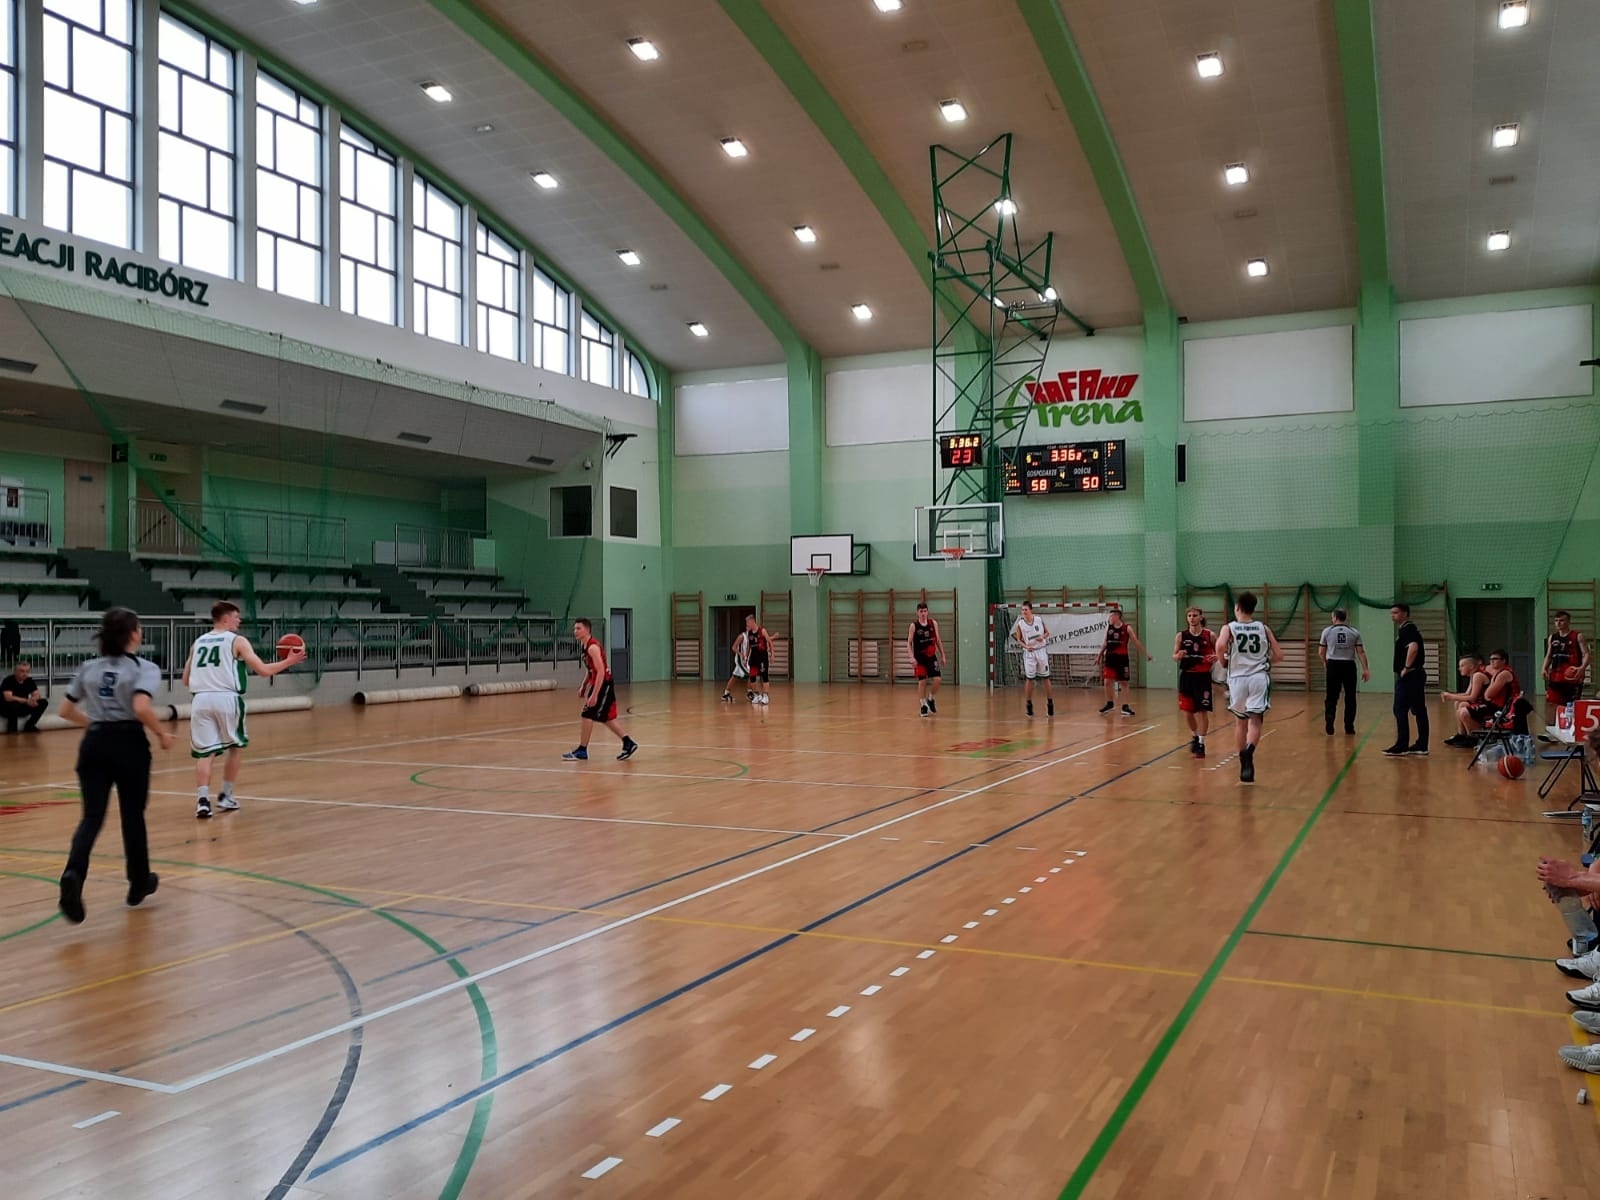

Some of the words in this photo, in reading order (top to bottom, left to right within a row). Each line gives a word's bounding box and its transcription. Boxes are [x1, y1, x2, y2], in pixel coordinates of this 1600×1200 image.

[0, 226, 75, 271] EACJI
[85, 250, 209, 307] RACIBÓRZ
[1024, 368, 1140, 405] RAFAKO
[952, 449, 972, 465] 23
[1026, 468, 1058, 477] GOSPODARZE
[1031, 479, 1047, 491] 58
[1082, 476, 1099, 489] 50
[1059, 632, 1068, 642] W
[1236, 632, 1261, 654] 23
[196, 645, 221, 668] 24
